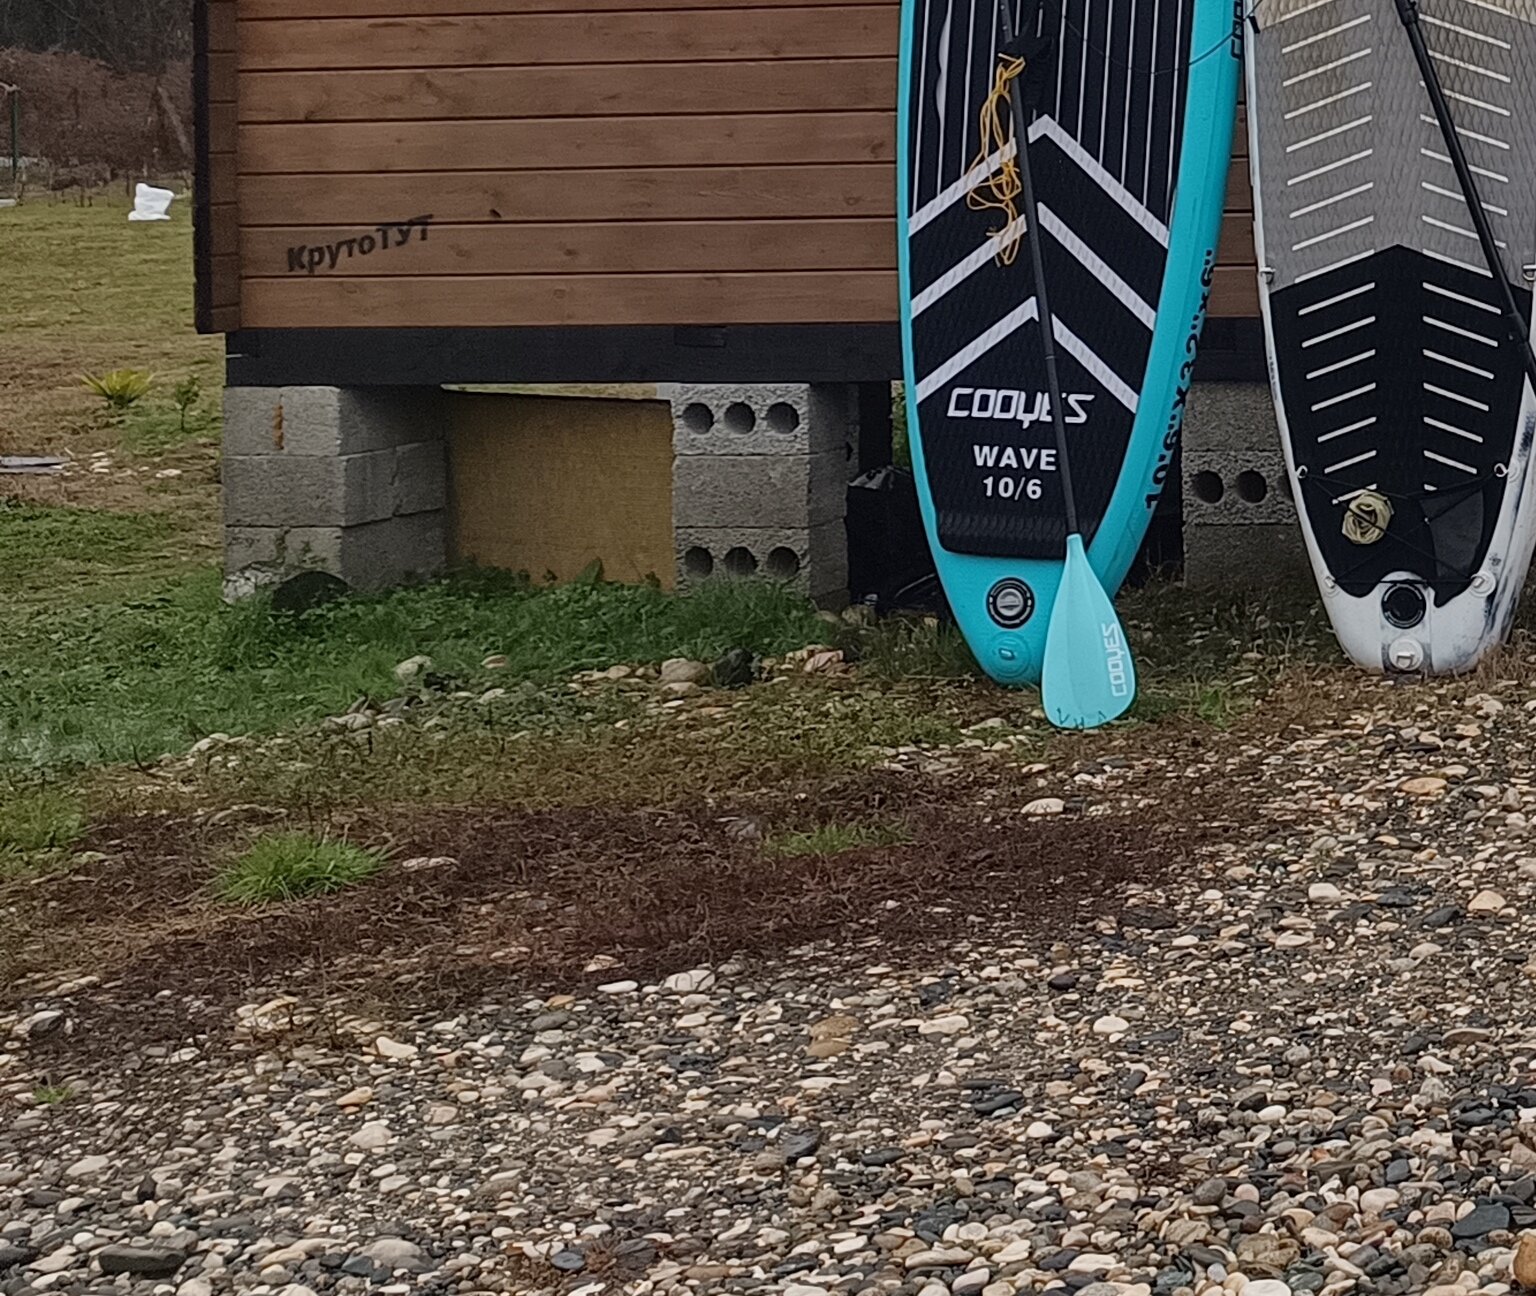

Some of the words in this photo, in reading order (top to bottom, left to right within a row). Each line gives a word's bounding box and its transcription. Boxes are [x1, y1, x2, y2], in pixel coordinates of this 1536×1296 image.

[946, 387, 1096, 430] COOYES
[973, 444, 1058, 471] WAVE
[982, 475, 1043, 501] 10/6
[1101, 621, 1128, 698] COOYES
